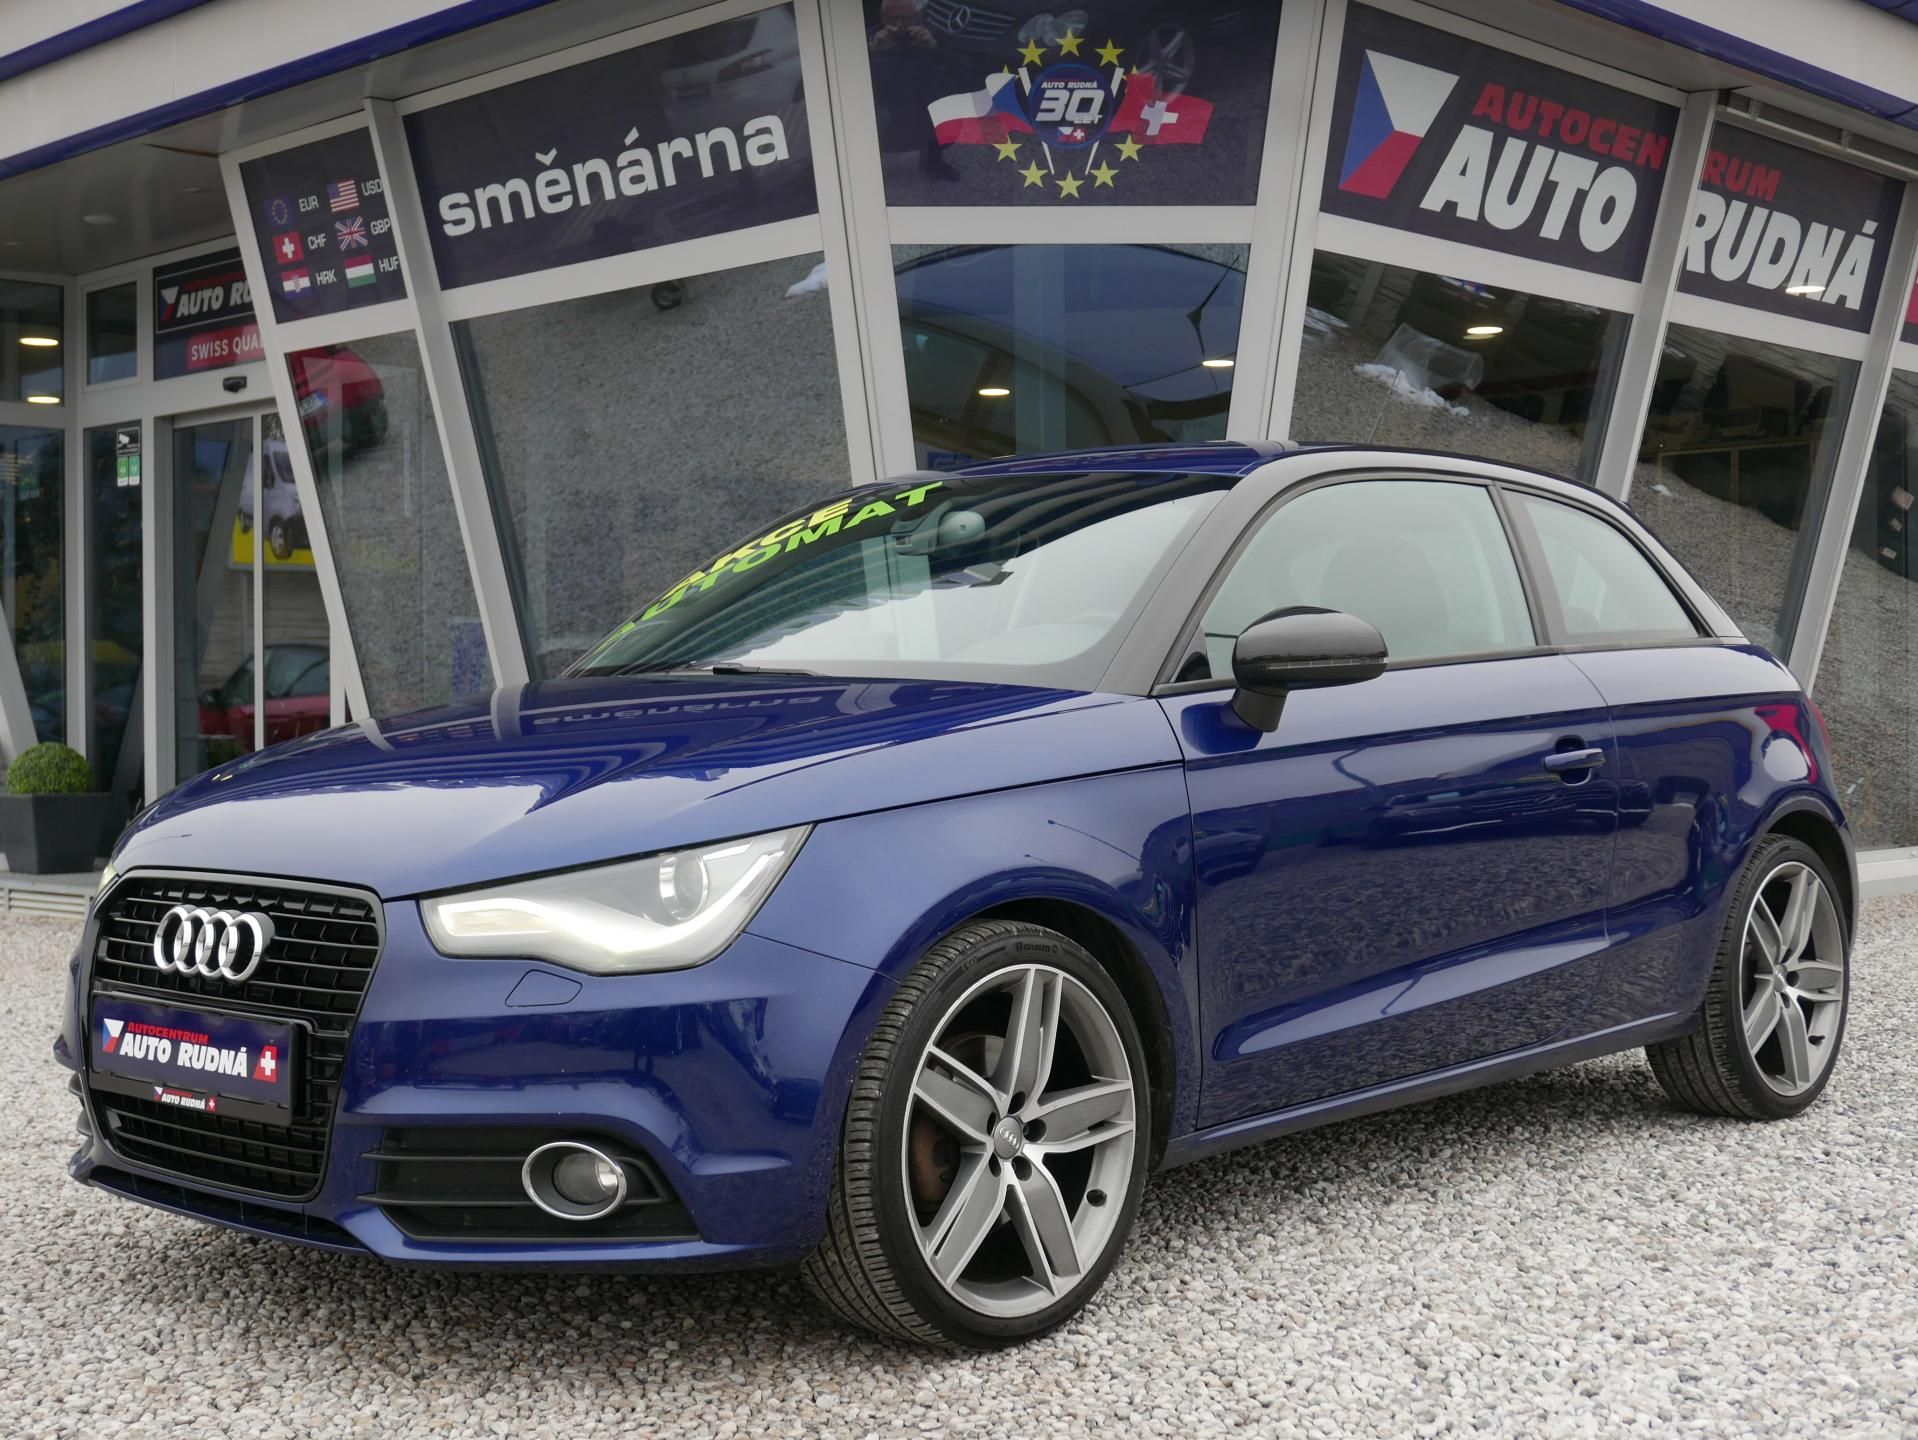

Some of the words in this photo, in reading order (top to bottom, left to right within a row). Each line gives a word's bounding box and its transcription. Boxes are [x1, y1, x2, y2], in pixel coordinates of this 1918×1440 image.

[1041, 81, 1065, 89] AUTO
[1035, 89, 1105, 121] 30
[438, 114, 789, 237] směnárna
[299, 195, 319, 212] EUR
[361, 178, 383, 196] USD
[1419, 124, 1638, 252] AUTO
[1683, 189, 1879, 311] RUDNÁ
[307, 233, 327, 250] CHF
[370, 218, 391, 235] GBP
[315, 269, 337, 286] HRK
[378, 255, 399, 273] HUF
[176, 286, 224, 318] AUTO
[191, 339, 229, 361] SWISS
[232, 333, 264, 354] QUA
[127, 1021, 209, 1045] AUTOCENTRUM
[119, 1032, 172, 1064] AUTO
[177, 1041, 248, 1078] RUDNÁ
[161, 1093, 180, 1105] AUTO
